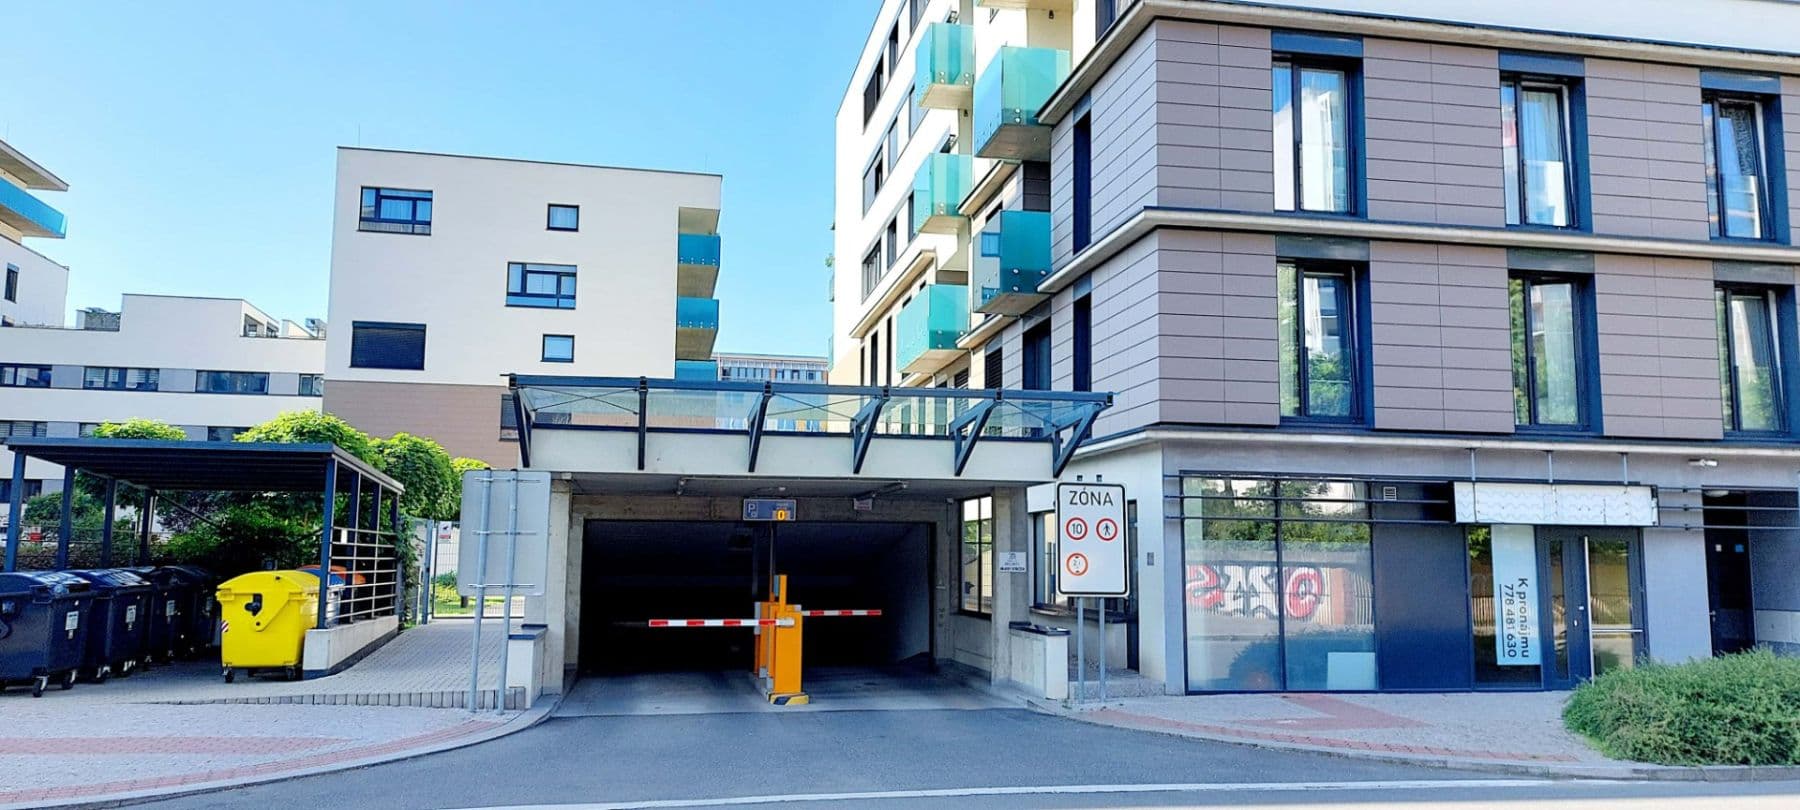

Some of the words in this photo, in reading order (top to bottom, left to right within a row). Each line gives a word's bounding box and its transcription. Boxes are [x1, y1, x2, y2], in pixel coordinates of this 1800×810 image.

[1069, 487, 1113, 506] ZÓNA
[1072, 523, 1083, 535] 10
[1518, 578, 1528, 587] K
[1504, 584, 1514, 605] 778
[1505, 609, 1515, 630] 481
[1516, 591, 1530, 658] pronájmu
[1507, 633, 1517, 658] 630
